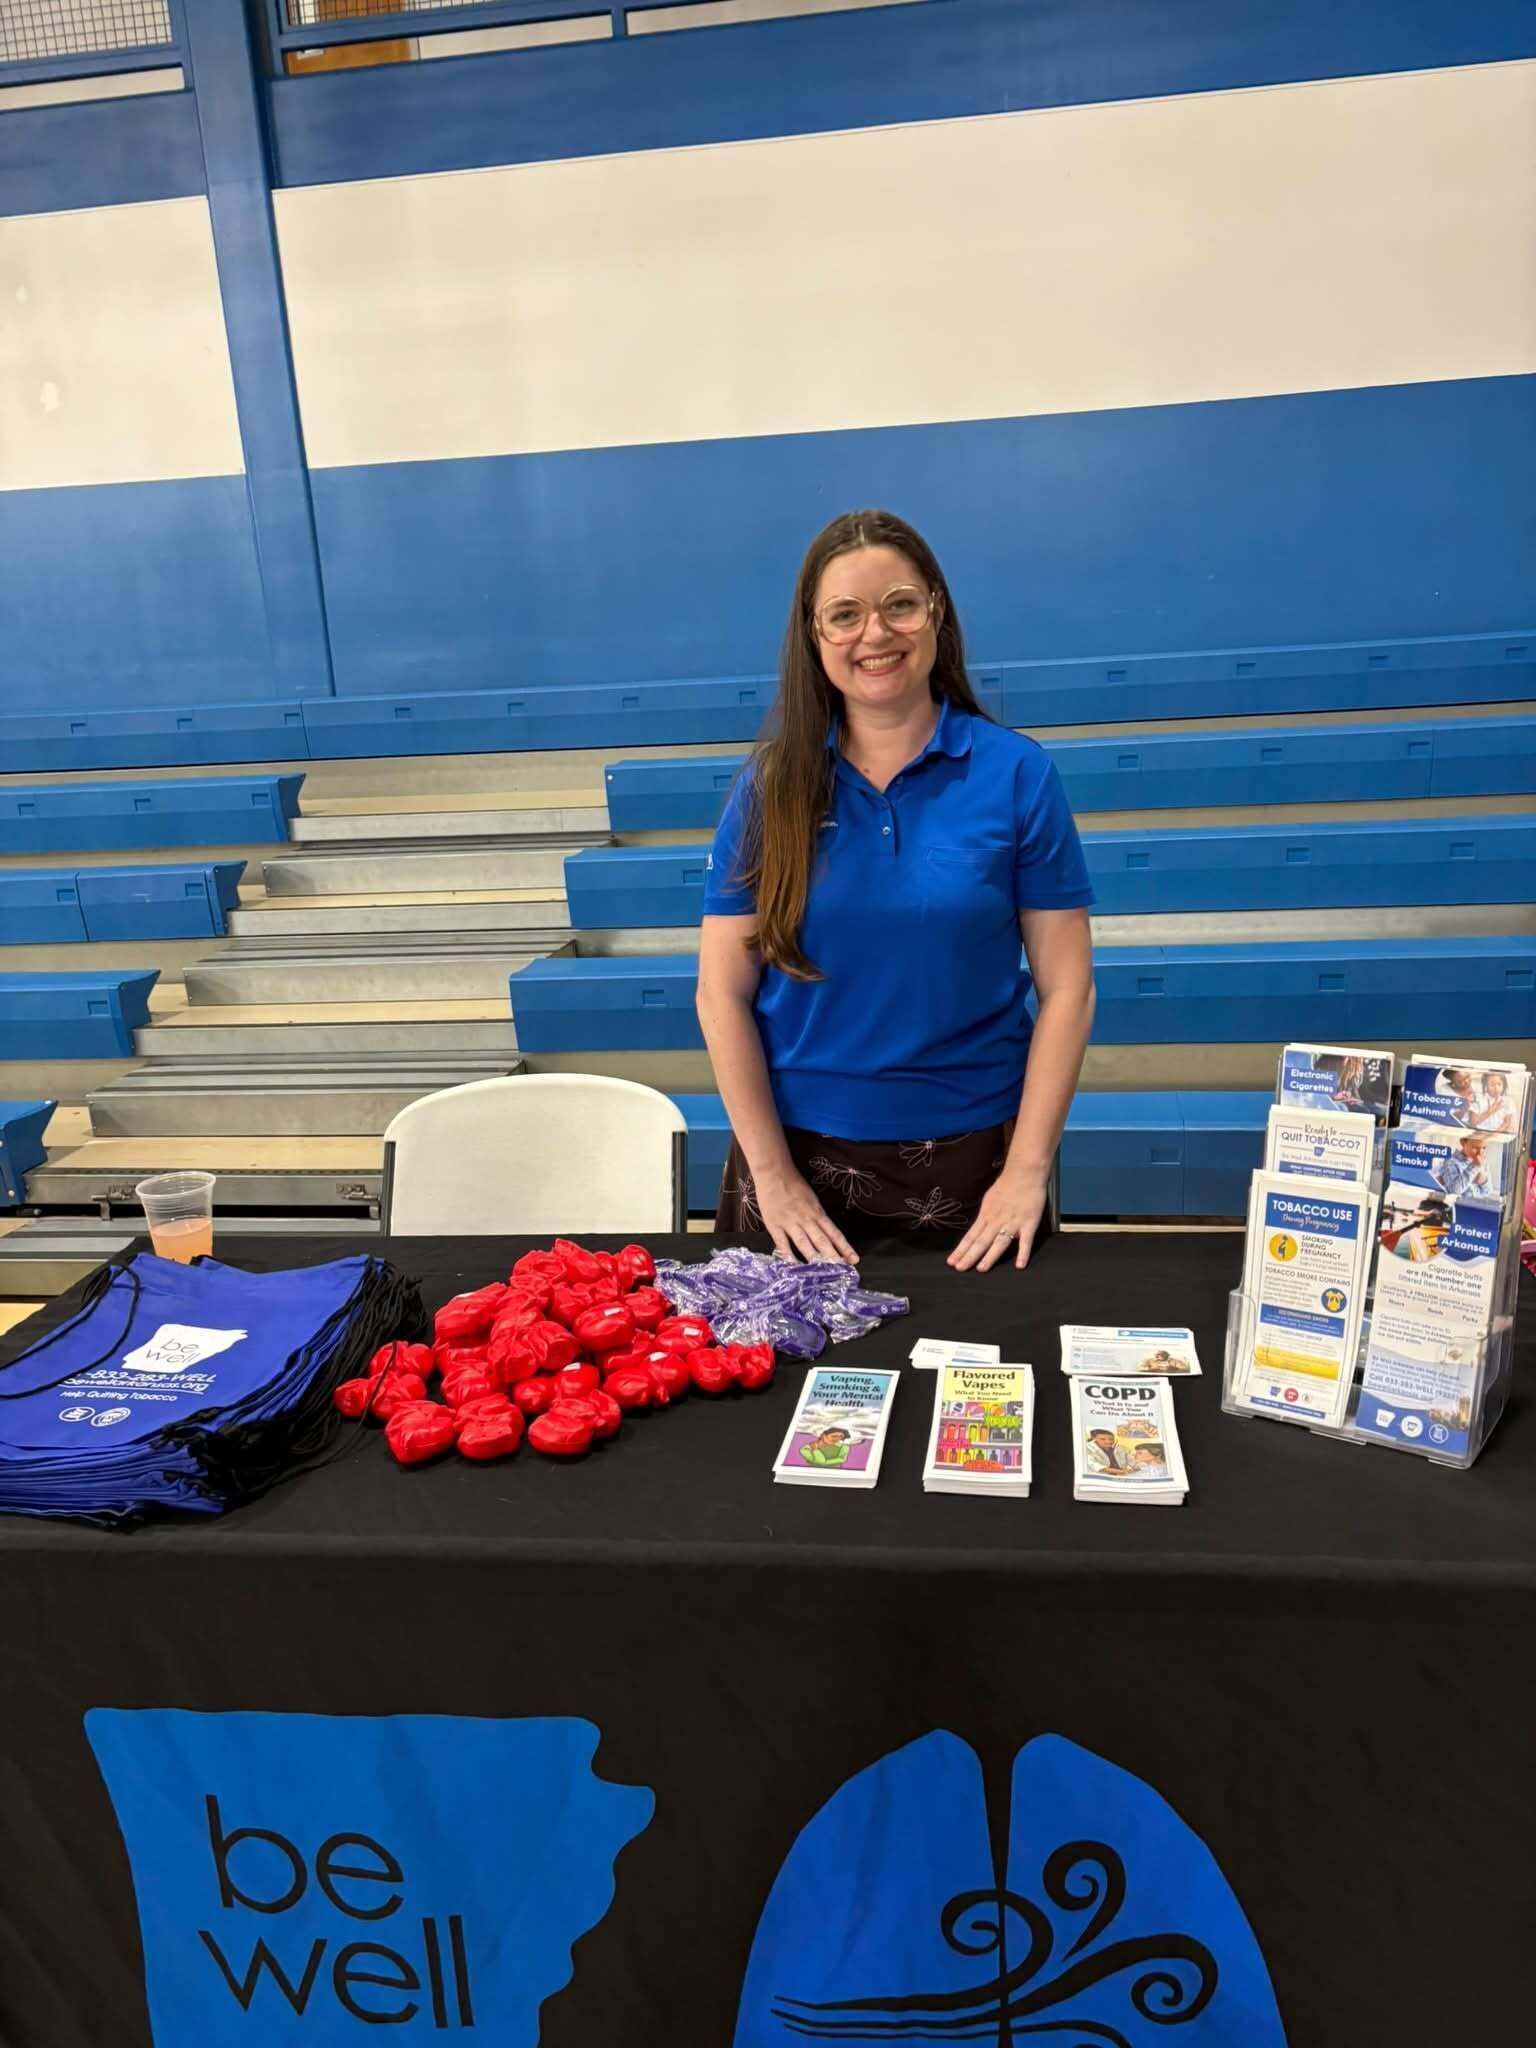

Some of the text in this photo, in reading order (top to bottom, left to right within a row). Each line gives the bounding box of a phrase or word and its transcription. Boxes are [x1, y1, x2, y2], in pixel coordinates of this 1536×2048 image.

[1291, 1069, 1333, 1081] Electronic
[1290, 1081, 1334, 1093] Cigarettes
[1413, 1092, 1451, 1105] Tobacco
[1454, 1097, 1463, 1106] &
[1411, 1105, 1446, 1117] Asthma
[1305, 1124, 1328, 1137] Ready
[1281, 1132, 1361, 1150] QUIT TOBACCO?
[1396, 1141, 1447, 1155] Thirdhand
[1396, 1155, 1428, 1167] Smoke
[1272, 1200, 1353, 1221] TOBACCO USE
[1282, 1214, 1340, 1232] During Pregnancy
[1454, 1225, 1492, 1240] Protect
[1302, 1235, 1333, 1245] SMOKING
[1441, 1237, 1490, 1254] Arkansas
[1301, 1248, 1342, 1260] PREGNANCY
[1265, 1266, 1296, 1277] TOBACCO
[1428, 1264, 1482, 1281] Cigarette butts
[1421, 1271, 1433, 1279] the
[1435, 1274, 1465, 1285] number
[1467, 1281, 1482, 1289] one
[161, 1338, 199, 1353] be
[146, 1350, 200, 1363] well
[830, 1375, 875, 1385] Vaping,
[953, 1370, 1016, 1380] Flavored
[819, 1383, 870, 1393] Smoking
[962, 1380, 1006, 1390] Vapes
[60, 1391, 178, 1402] Help Quitting Tobacco
[813, 1391, 884, 1401] Your Mental
[1085, 1385, 1156, 1400] COPD
[825, 1400, 864, 1408] Health
[205, 1794, 404, 1920] be
[198, 1914, 475, 2029] well
